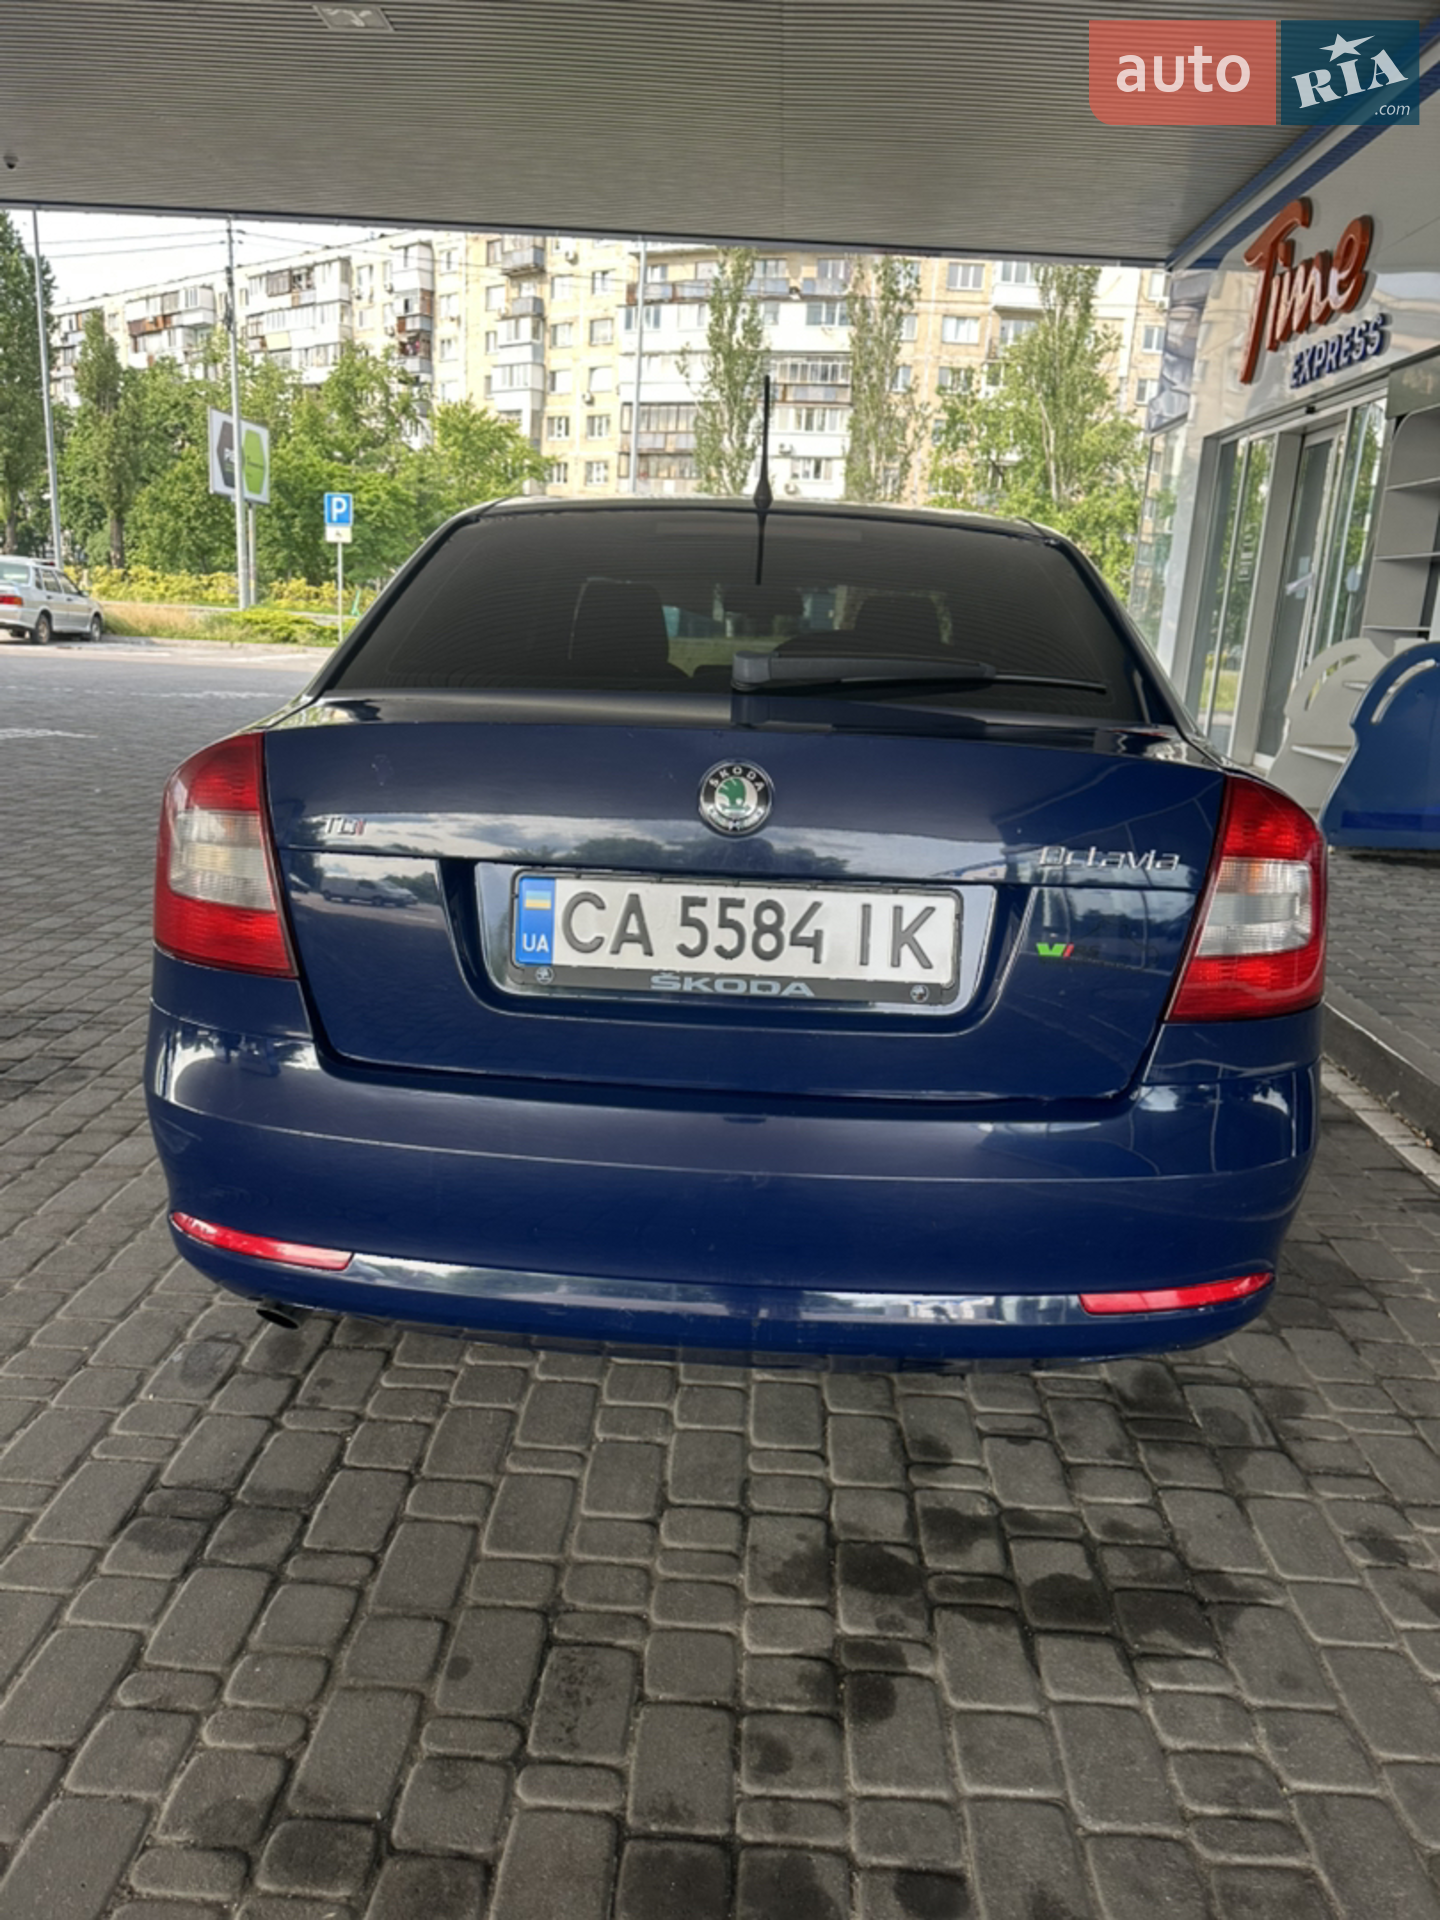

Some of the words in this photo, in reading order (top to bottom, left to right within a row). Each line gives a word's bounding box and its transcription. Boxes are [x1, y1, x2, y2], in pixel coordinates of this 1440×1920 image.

[1240, 196, 1374, 385] Time
[1290, 313, 1389, 389] EXPRESS
[331, 497, 347, 522] P
[522, 933, 550, 953] UA
[561, 890, 655, 956] CA
[676, 895, 824, 964] 5584
[857, 902, 937, 970] IK
[650, 972, 816, 998] ŠKODA
